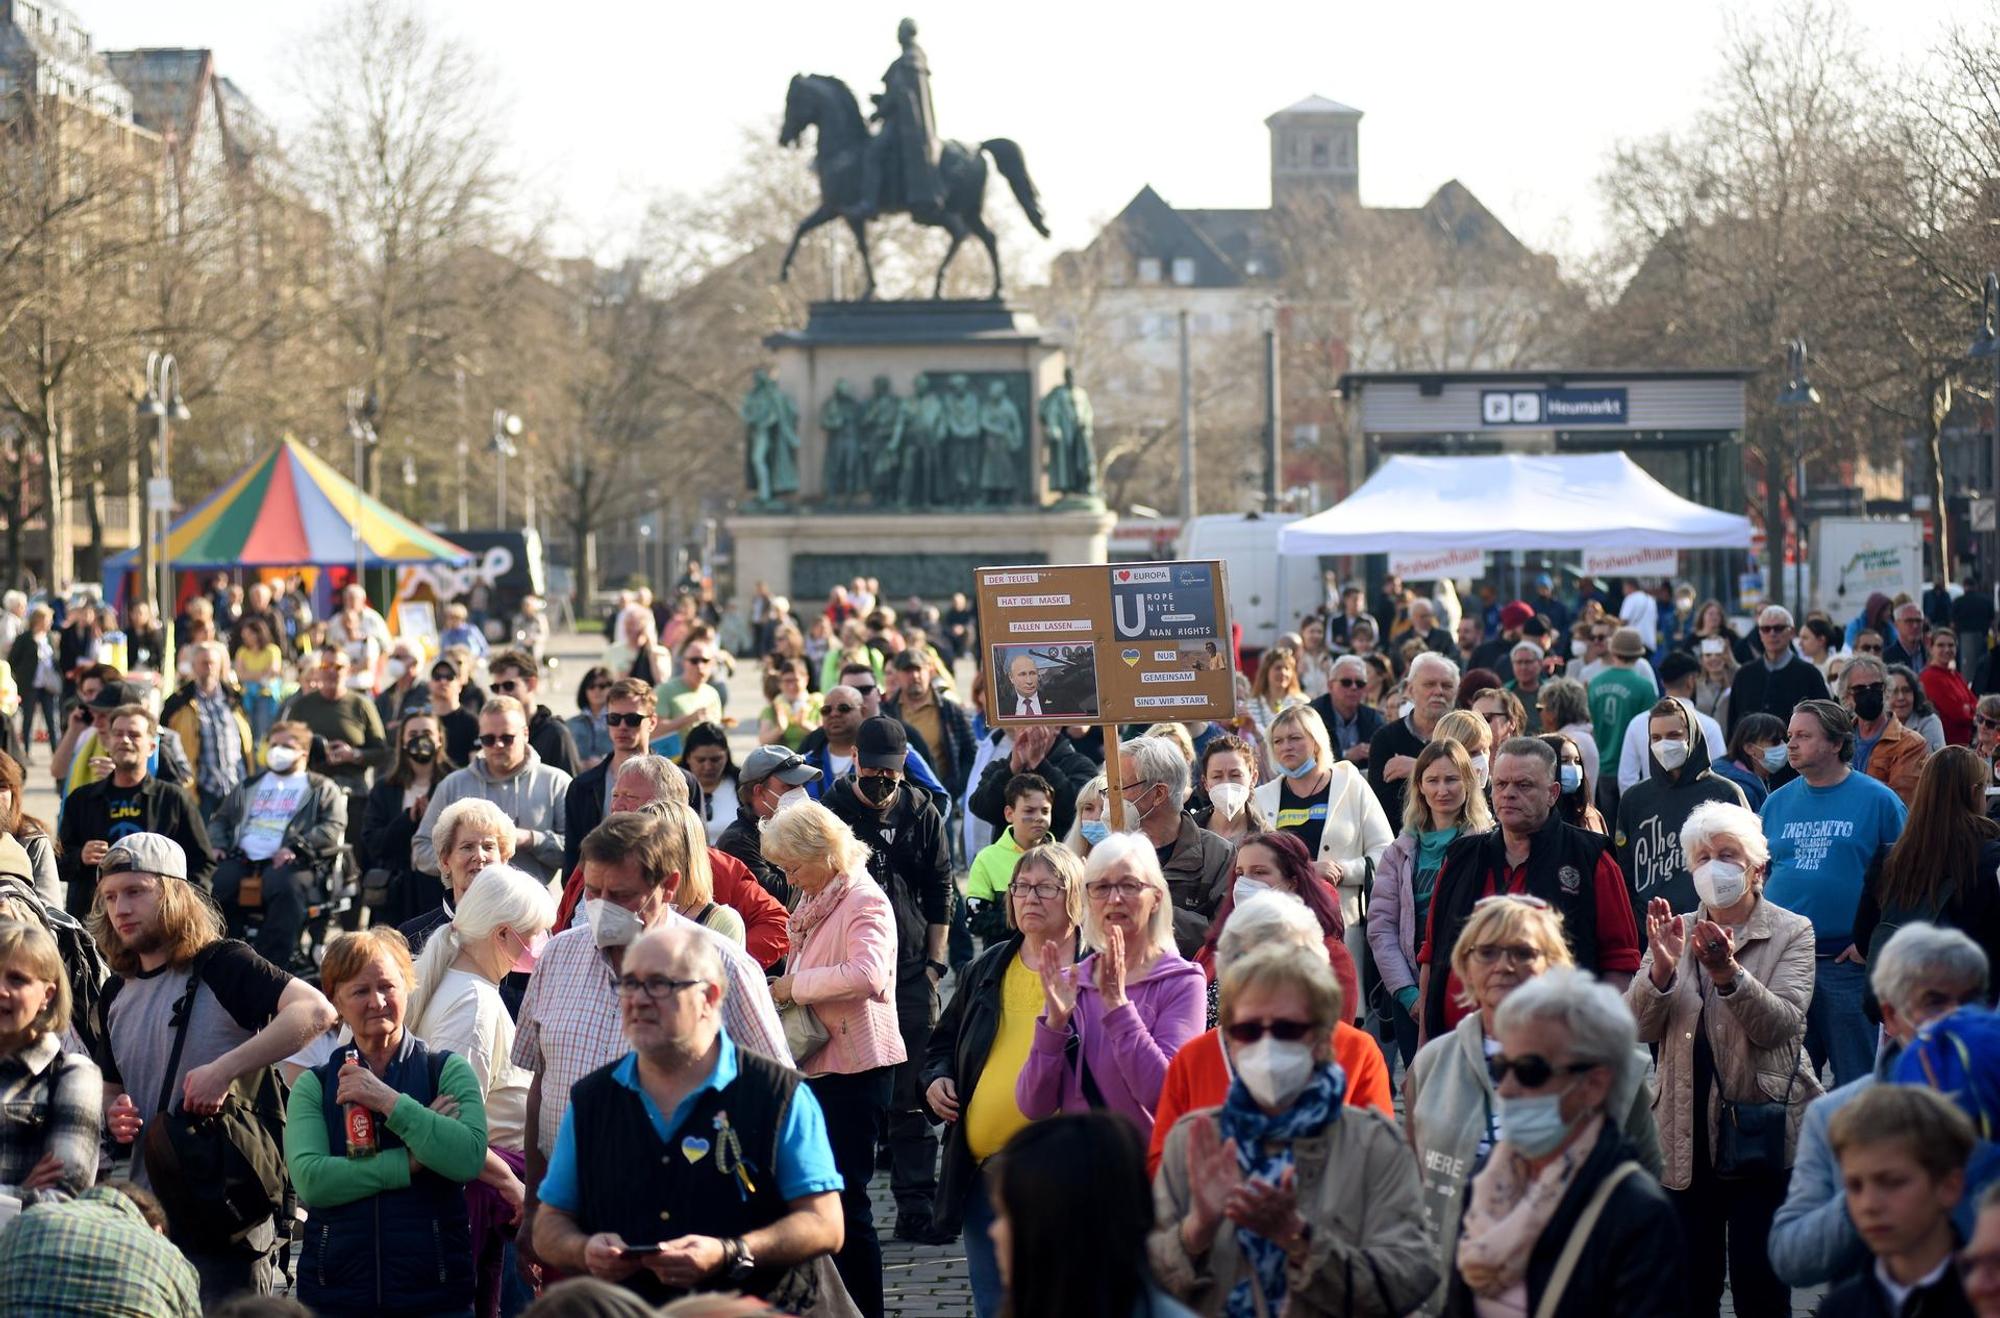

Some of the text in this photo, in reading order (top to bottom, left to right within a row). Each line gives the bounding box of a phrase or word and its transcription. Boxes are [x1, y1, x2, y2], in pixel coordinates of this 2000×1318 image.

[1548, 398, 1622, 415] Heumarkt
[988, 575, 1035, 584] DER TEUFEL
[1133, 571, 1167, 580] EUROPA
[1001, 596, 1066, 606] HAT DIE MASKE
[1114, 593, 1146, 637] U
[1013, 622, 1041, 631] FALLEN
[1149, 626, 1211, 637] MAN RIGHTS
[1157, 652, 1176, 660] NUR
[1143, 672, 1193, 682] GEMEINSAM
[1136, 698, 1156, 706] SIND
[1180, 696, 1206, 705] STARK
[1781, 820, 1854, 840] INCOGNITO
[1638, 813, 1677, 860] The
